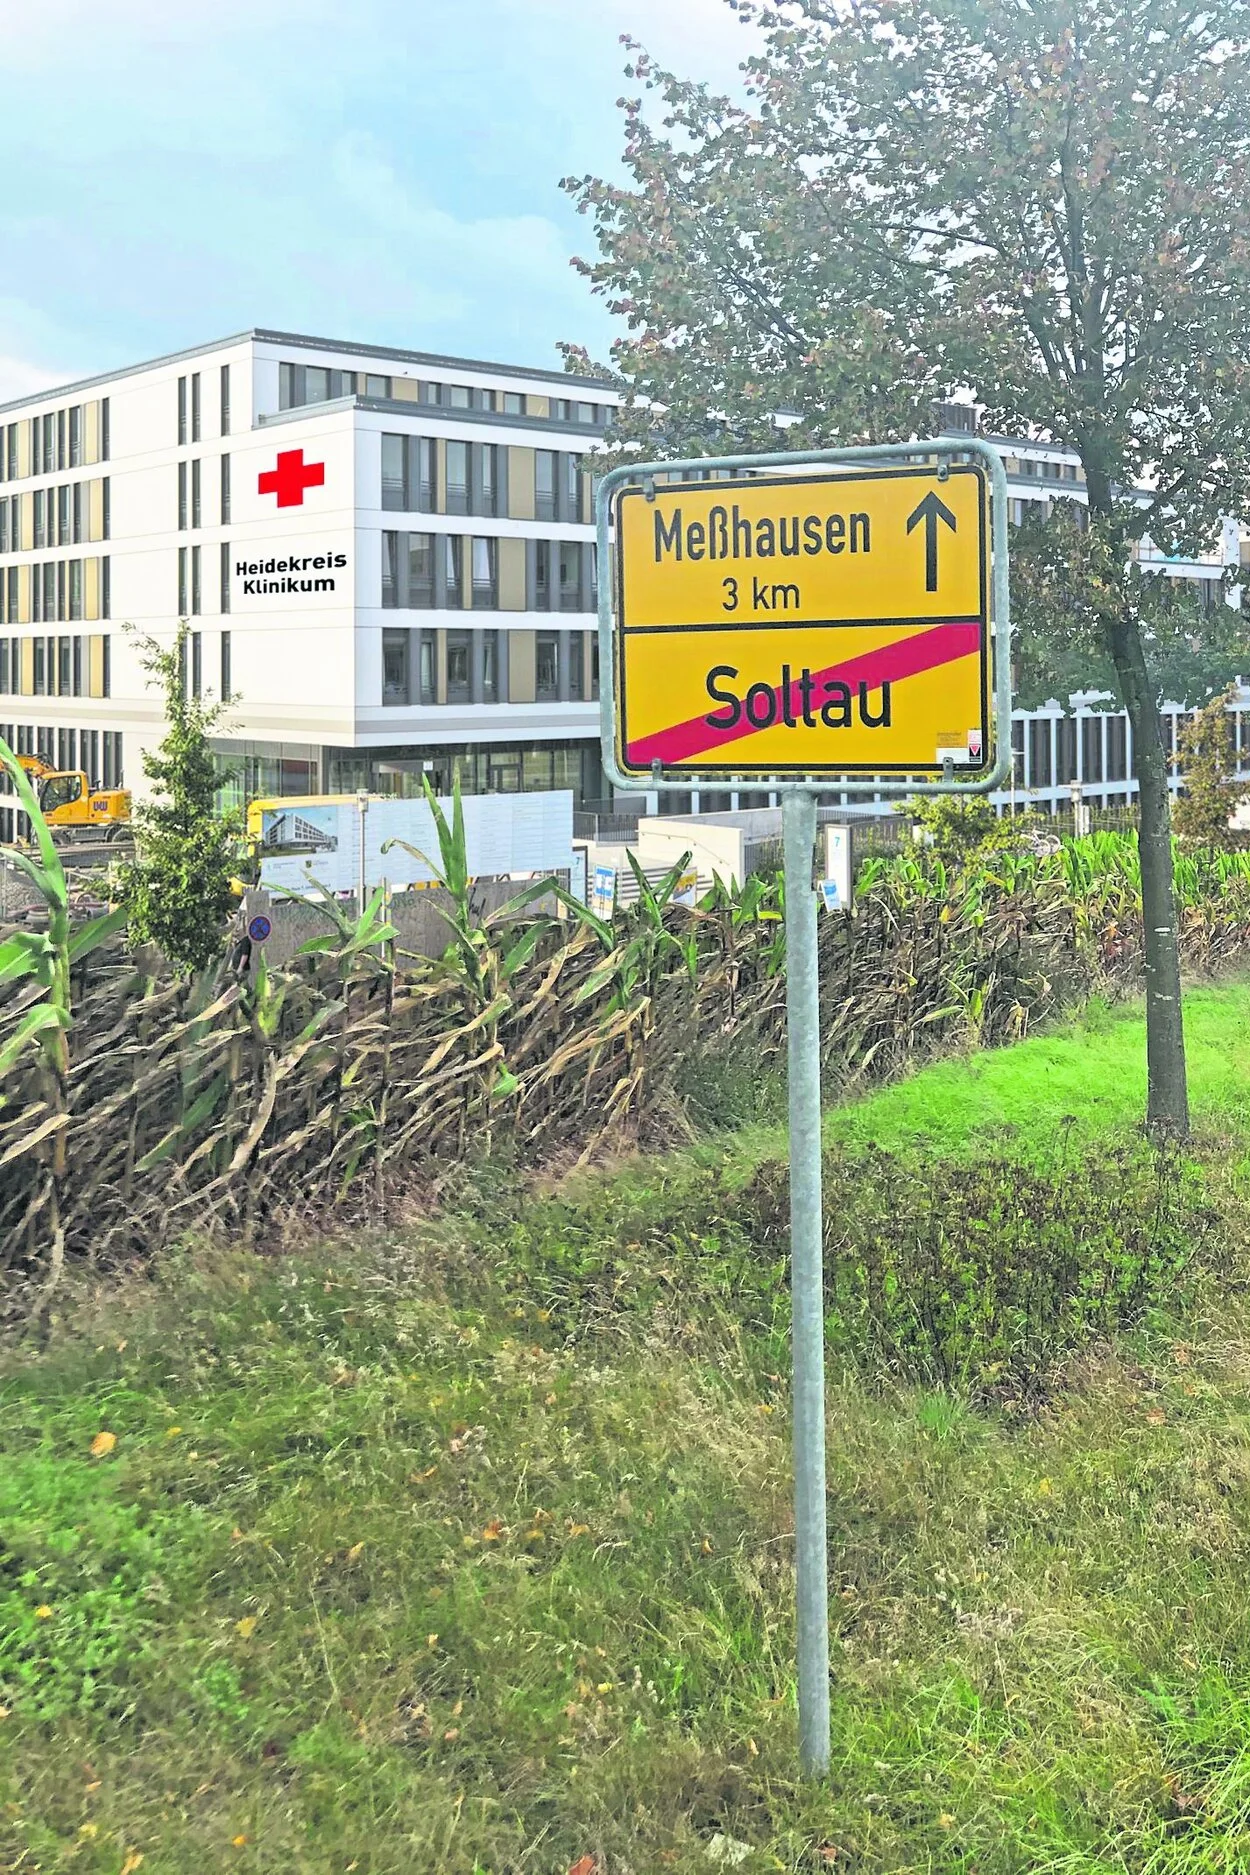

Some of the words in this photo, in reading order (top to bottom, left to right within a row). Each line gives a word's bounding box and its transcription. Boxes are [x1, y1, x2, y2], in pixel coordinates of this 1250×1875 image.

[653, 505, 871, 563] Meßhausen
[236, 552, 347, 576] Heidekreis
[243, 577, 335, 595] Klinikum
[722, 577, 739, 611] 3
[752, 576, 800, 610] km
[705, 664, 892, 729] Soltau
